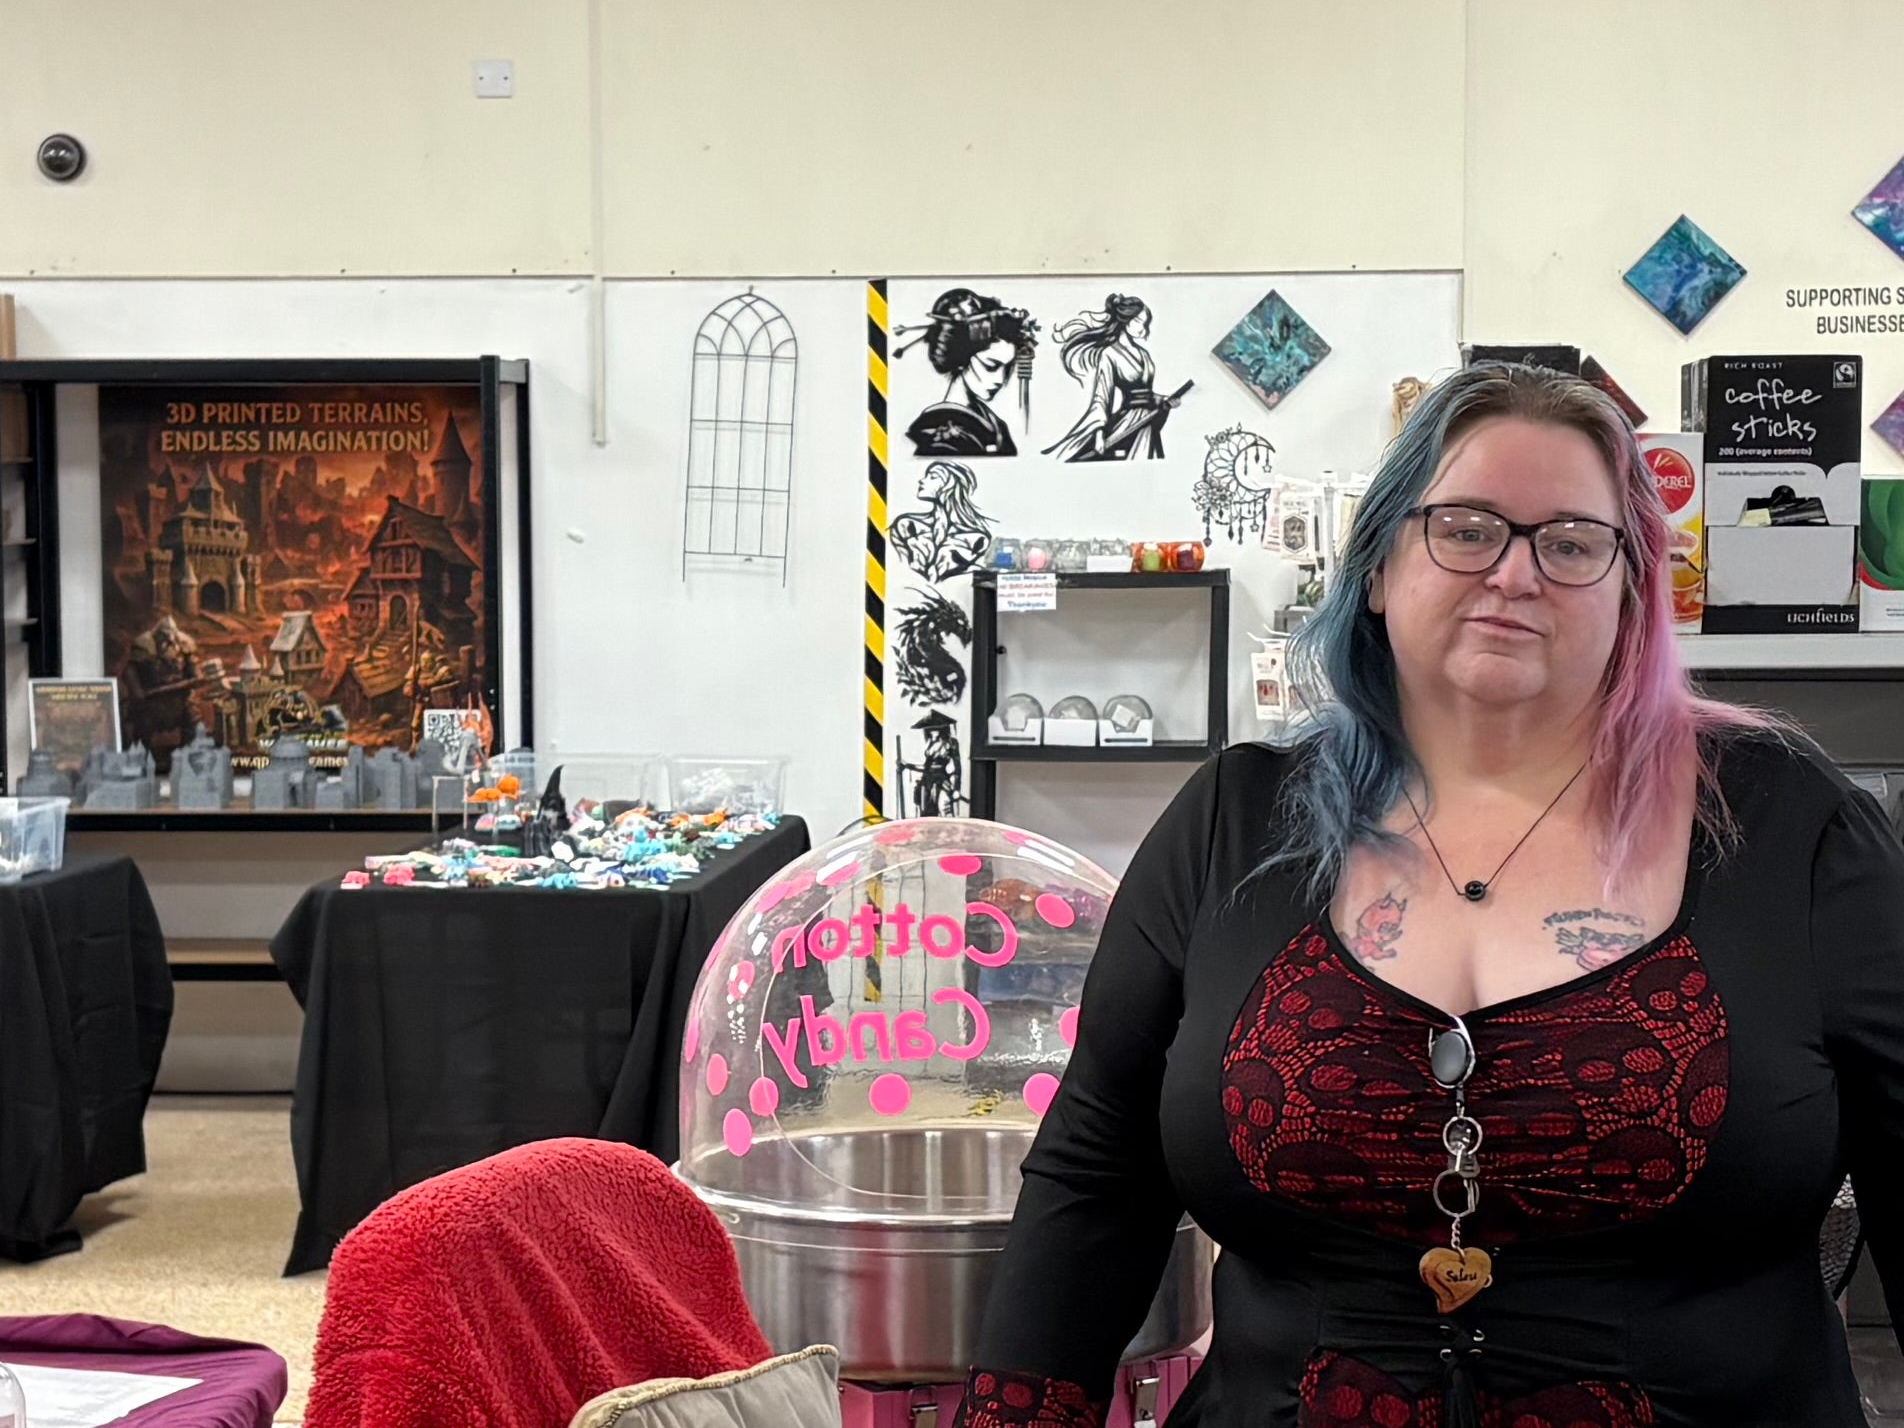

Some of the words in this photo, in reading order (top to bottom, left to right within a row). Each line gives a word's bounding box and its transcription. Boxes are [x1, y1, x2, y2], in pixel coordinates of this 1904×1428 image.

[1786, 286, 1892, 308] SUPPORTING
[1725, 378, 1823, 411] coffee
[166, 402, 196, 424] 3D
[203, 402, 301, 425] PRINTED
[309, 402, 428, 427] TERRAINS,
[161, 430, 261, 452] ENDLESS
[268, 429, 430, 452] IMAGINATION!
[1731, 413, 1817, 443] sticks
